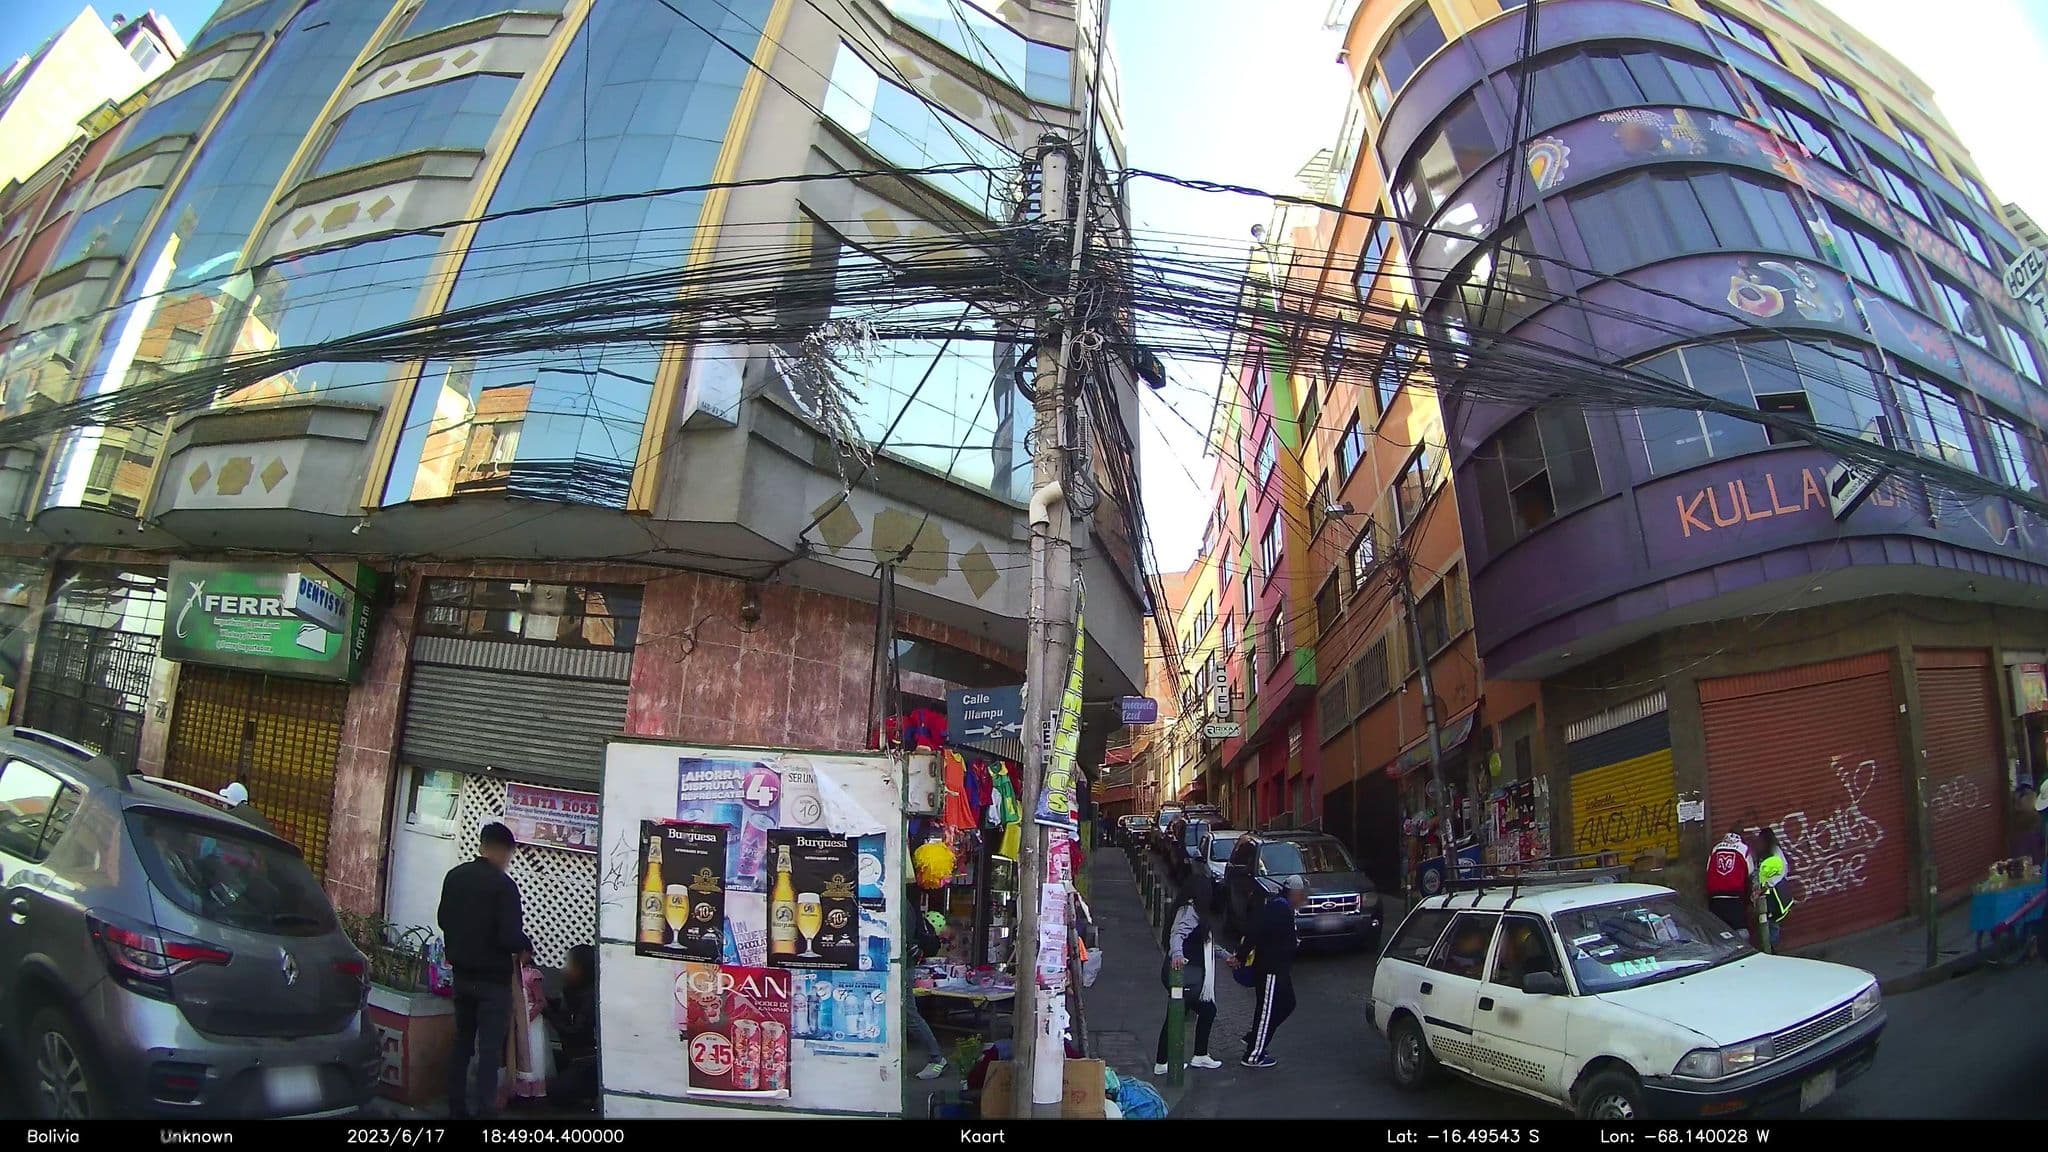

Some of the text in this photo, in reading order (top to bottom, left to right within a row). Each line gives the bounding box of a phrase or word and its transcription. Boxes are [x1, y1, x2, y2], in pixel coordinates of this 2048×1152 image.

[2007, 250, 2043, 296] HOTEL
[204, 595, 298, 618] FERR
[1216, 665, 1228, 714] HOTEL
[963, 693, 990, 705] Calle
[964, 709, 1003, 721] Illampu
[681, 779, 745, 792] DISFRUTA Y
[788, 773, 814, 784] SER UN
[562, 799, 599, 815] ROSA
[668, 828, 717, 843] Buguesa
[797, 836, 848, 849] Burguesa
[832, 913, 843, 924] 10
[1610, 956, 1661, 978] TAXI
[691, 971, 787, 1000] GRAN
